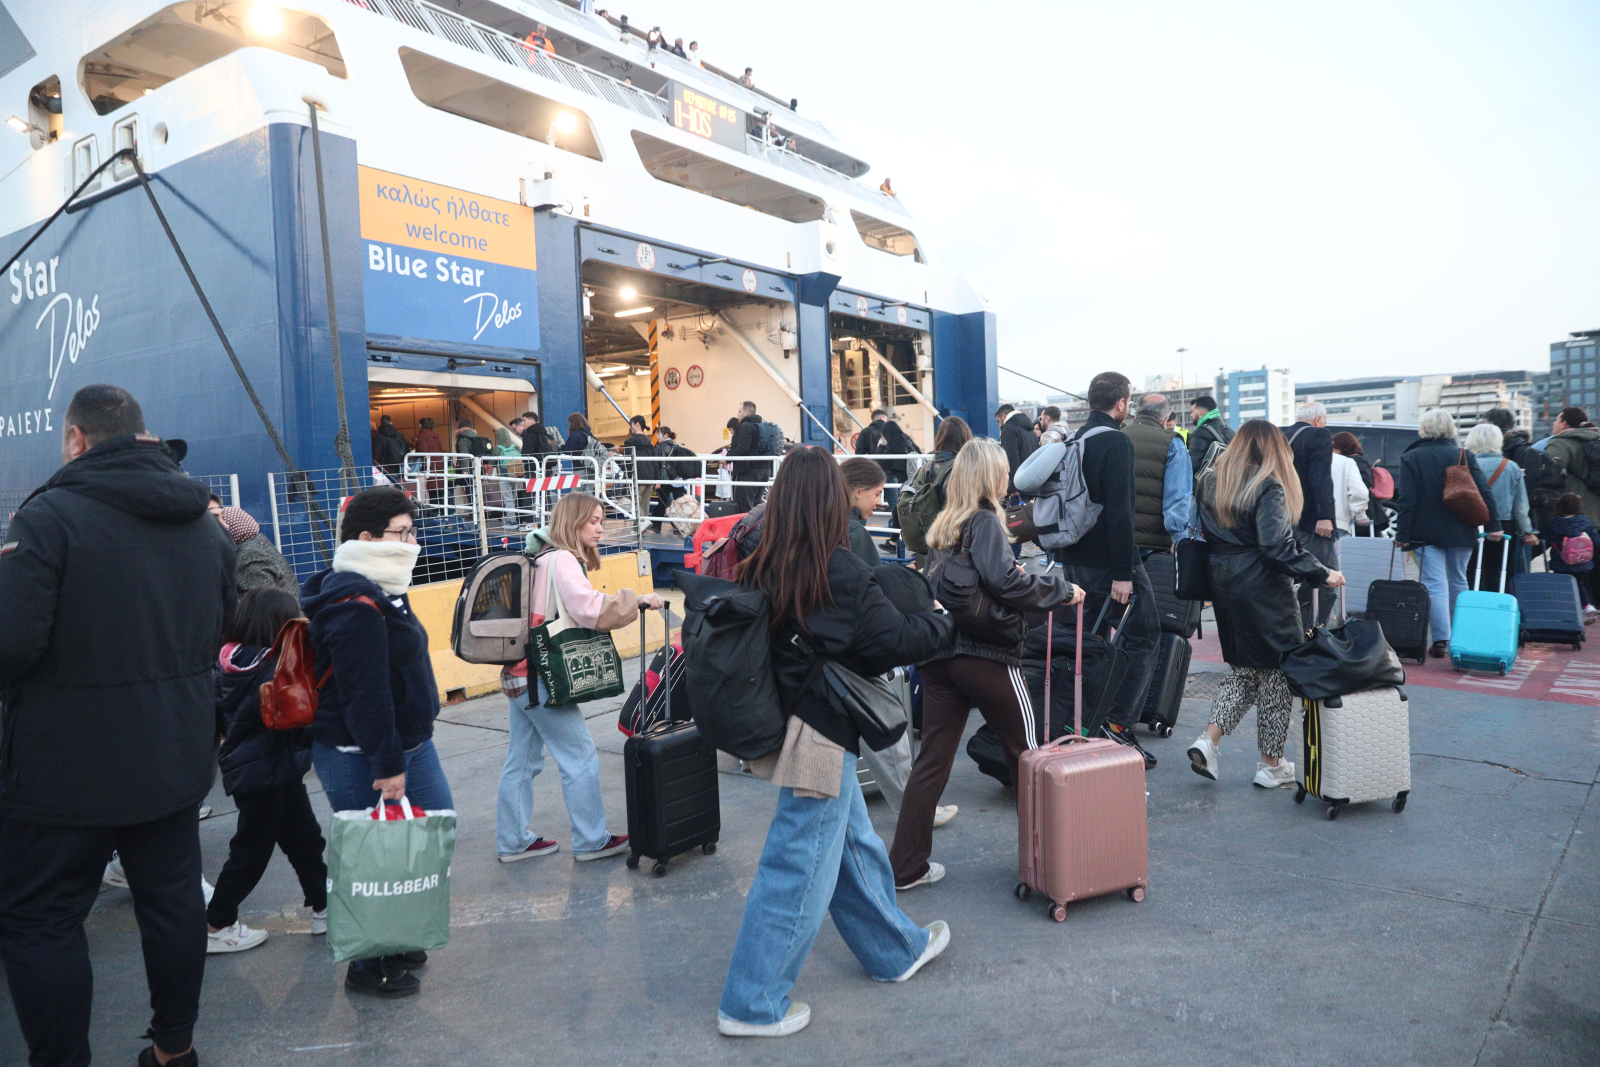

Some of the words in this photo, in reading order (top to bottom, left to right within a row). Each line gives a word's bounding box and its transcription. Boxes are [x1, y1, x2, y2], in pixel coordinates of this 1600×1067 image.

[377, 184, 441, 215] καλώς
[446, 196, 511, 228] ήλθατε
[405, 222, 488, 252] welcome
[9, 256, 59, 305] Star
[368, 243, 429, 279] Blue
[435, 256, 485, 288] Star
[463, 291, 523, 341] Delos
[35, 292, 101, 401] Delos
[536, 634, 549, 667] DAUNT
[352, 874, 439, 897] PULL&BEAR
